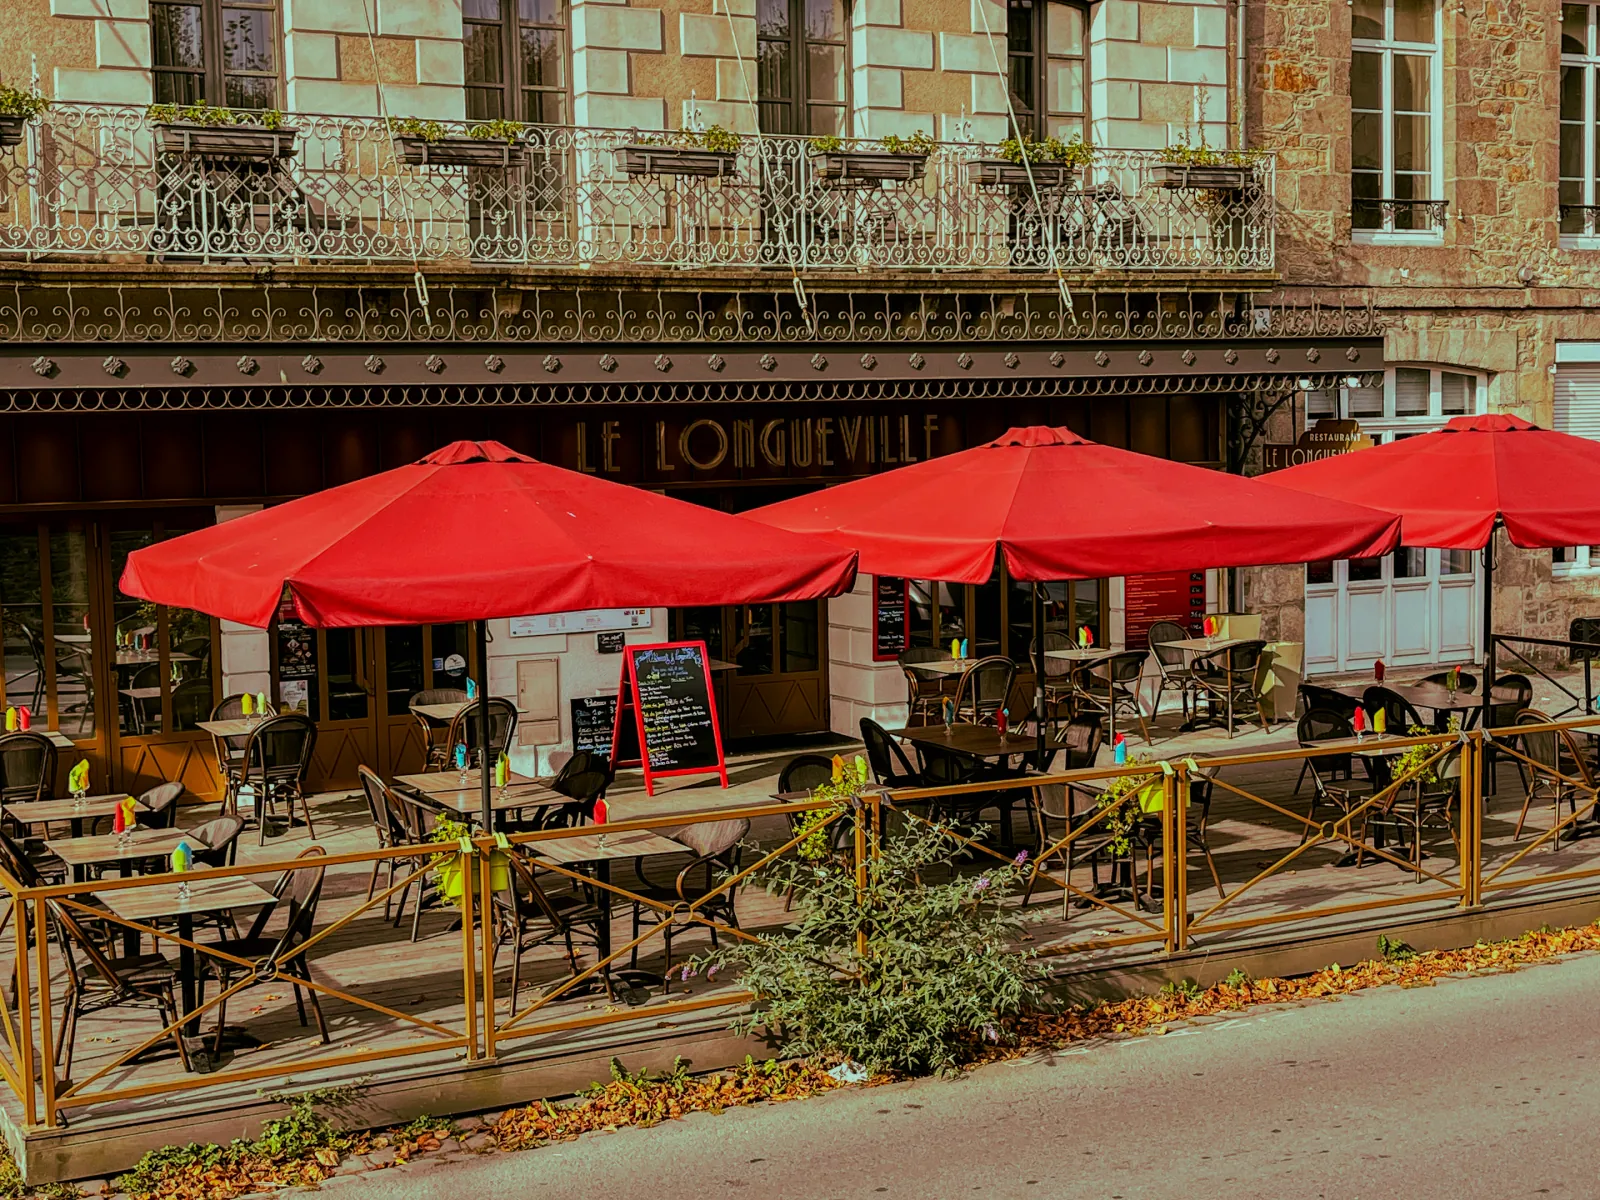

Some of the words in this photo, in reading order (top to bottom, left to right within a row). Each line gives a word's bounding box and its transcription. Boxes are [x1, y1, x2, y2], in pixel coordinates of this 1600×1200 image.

[577, 421, 620, 472] LE
[656, 414, 938, 471] LONGUEVILLE
[1309, 433, 1361, 442] RESTAURANT
[1265, 448, 1277, 467] LE
